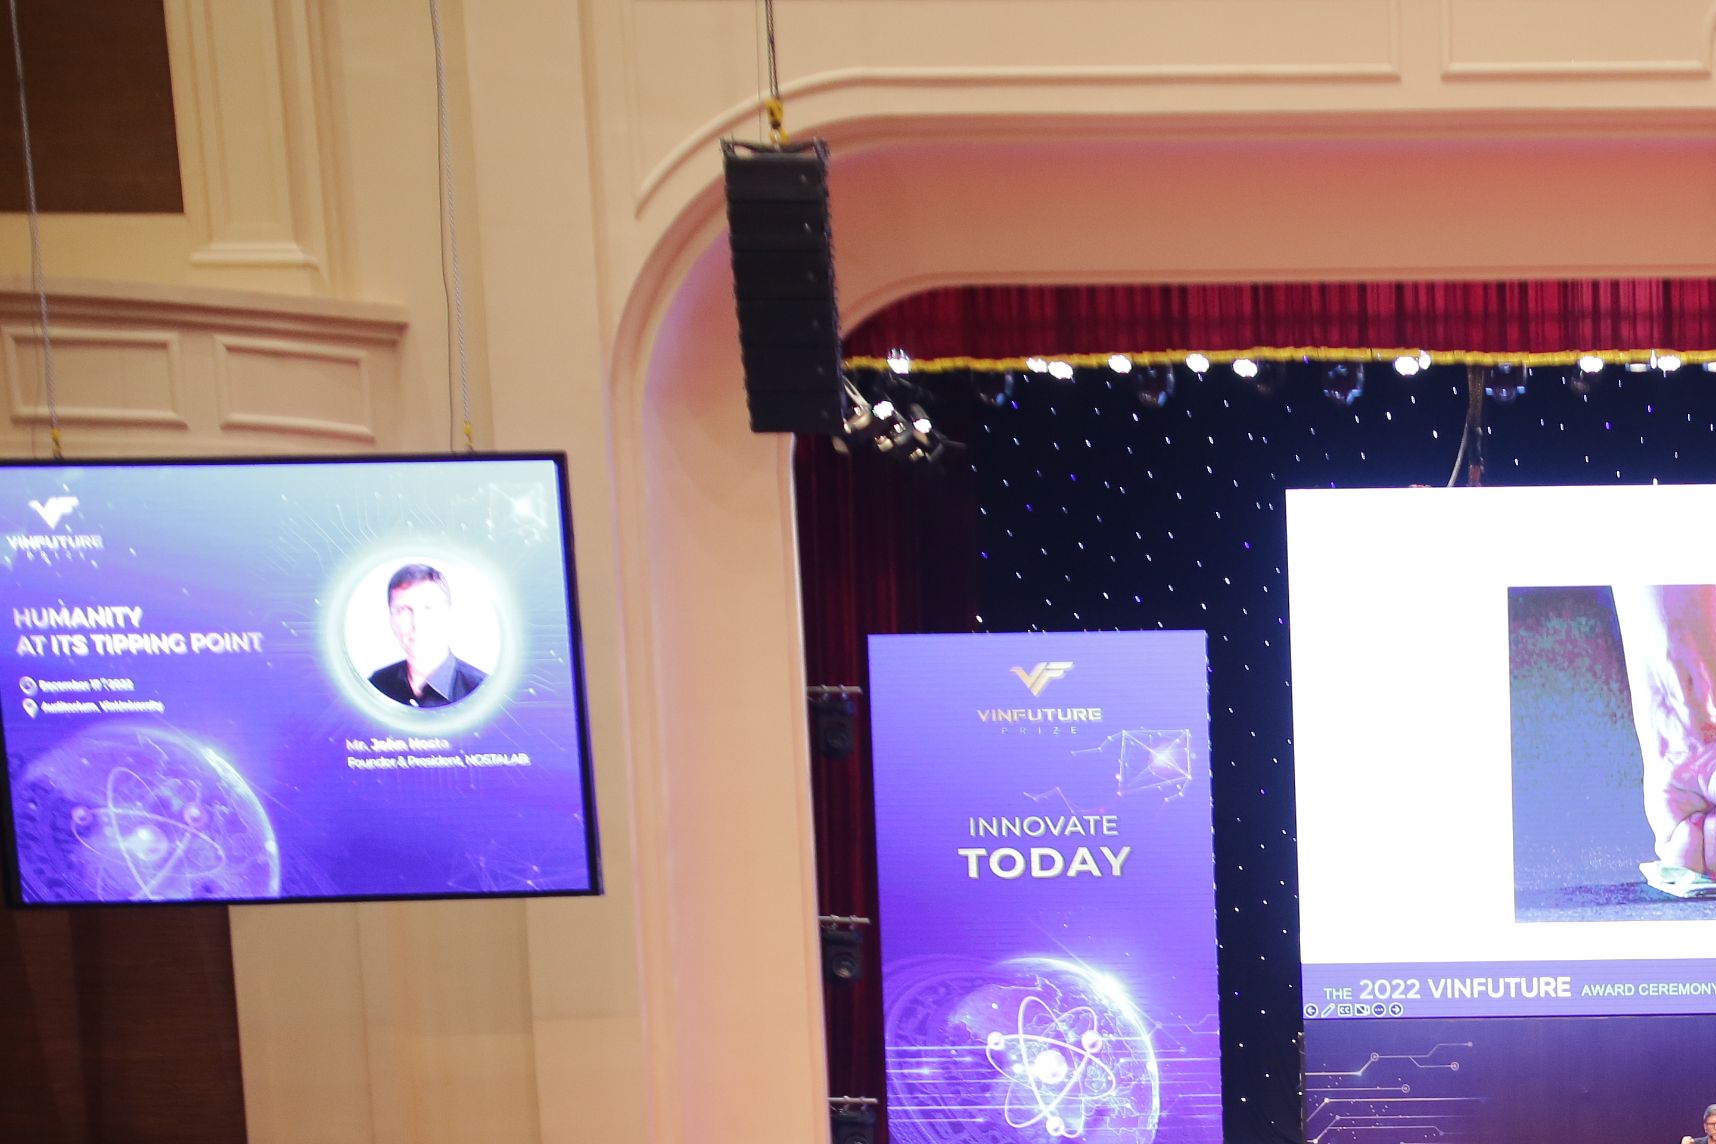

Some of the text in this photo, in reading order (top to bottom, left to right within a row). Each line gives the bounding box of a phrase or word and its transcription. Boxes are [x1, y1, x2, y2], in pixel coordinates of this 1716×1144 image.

[13, 606, 143, 629] HUMANITY
[16, 631, 264, 656] AT ITS TIPPING POINT
[977, 708, 1102, 723] VINFUTURE
[1001, 726, 1079, 735] PRIZE
[370, 736, 409, 752] John
[969, 815, 1119, 837] INNOVATE
[957, 846, 1131, 880] TODAY
[1323, 987, 1353, 1000] THE
[1359, 979, 1421, 1000] 2022
[1427, 976, 1572, 999] VINFUTURE
[1581, 983, 1635, 997] AWARD
